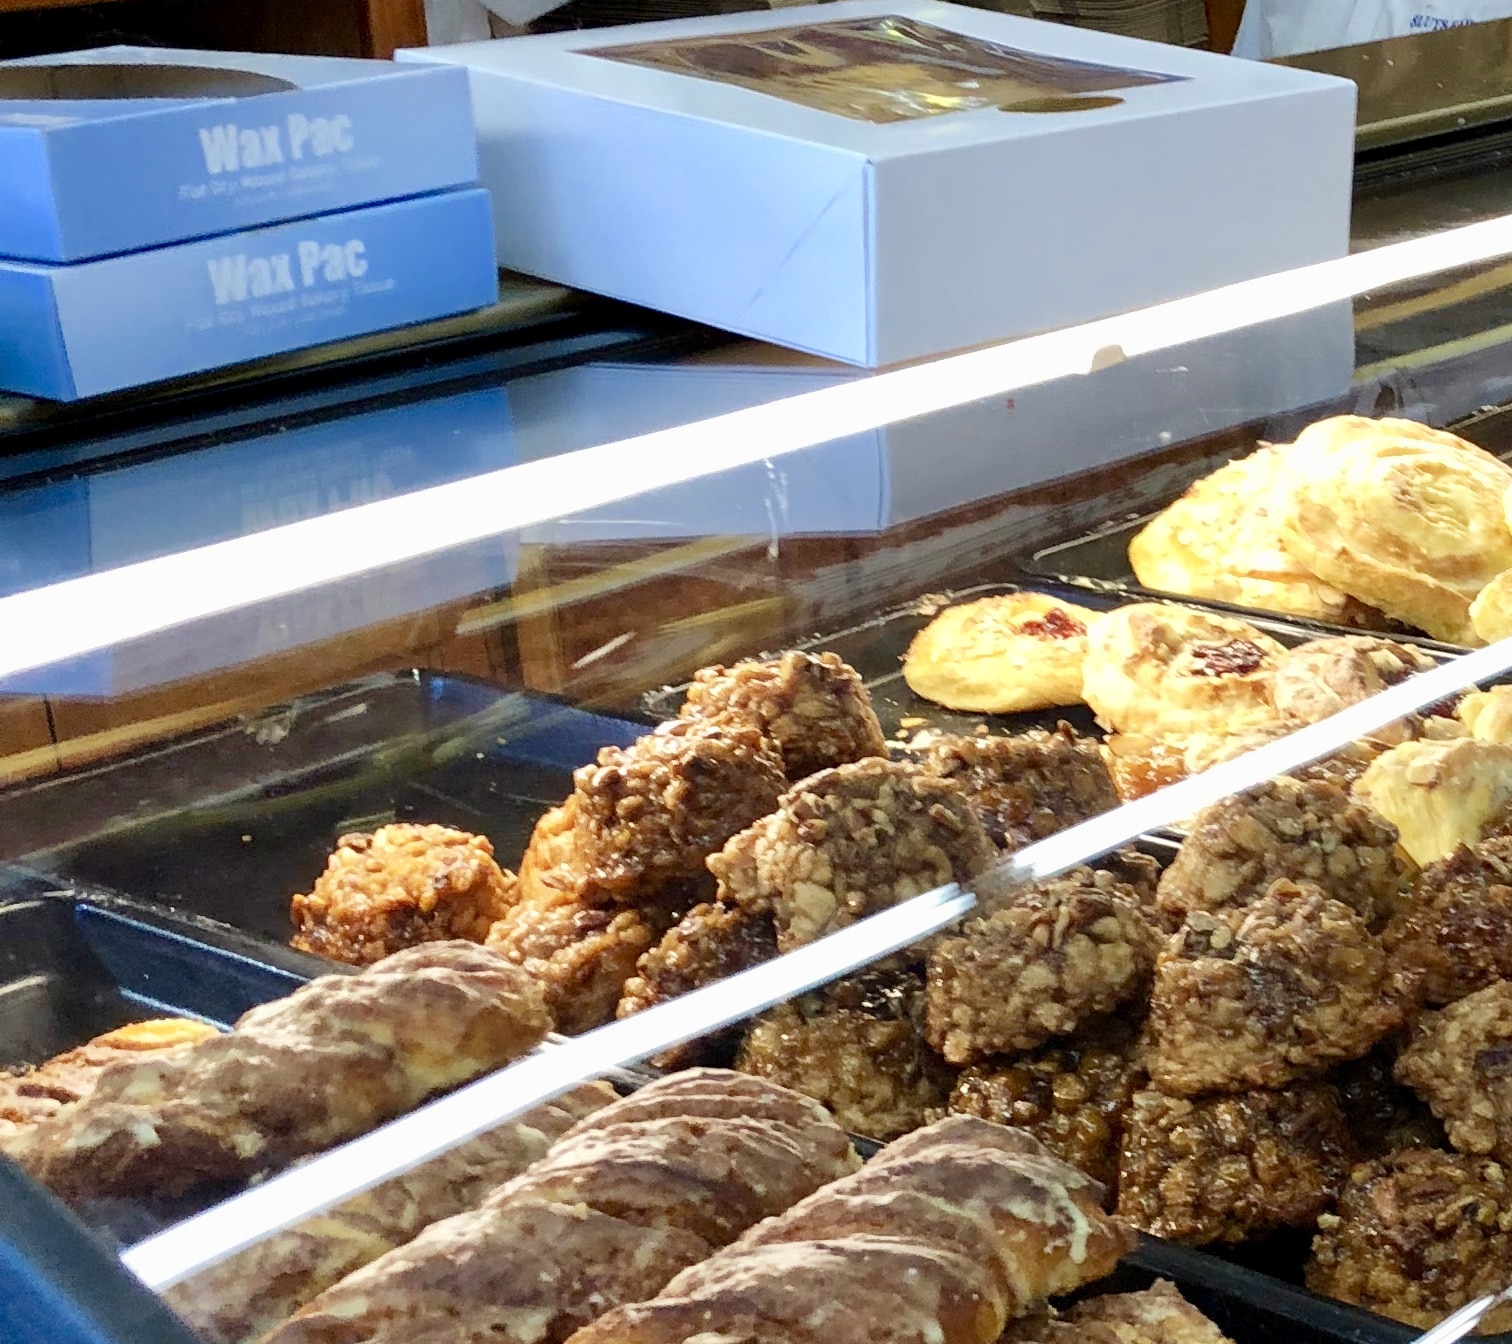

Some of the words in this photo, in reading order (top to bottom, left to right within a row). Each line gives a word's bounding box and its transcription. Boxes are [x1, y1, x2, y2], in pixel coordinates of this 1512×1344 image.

[199, 123, 284, 174] Wax
[287, 114, 355, 159] Pac
[207, 254, 295, 305] Wax
[298, 239, 369, 287] Pac
